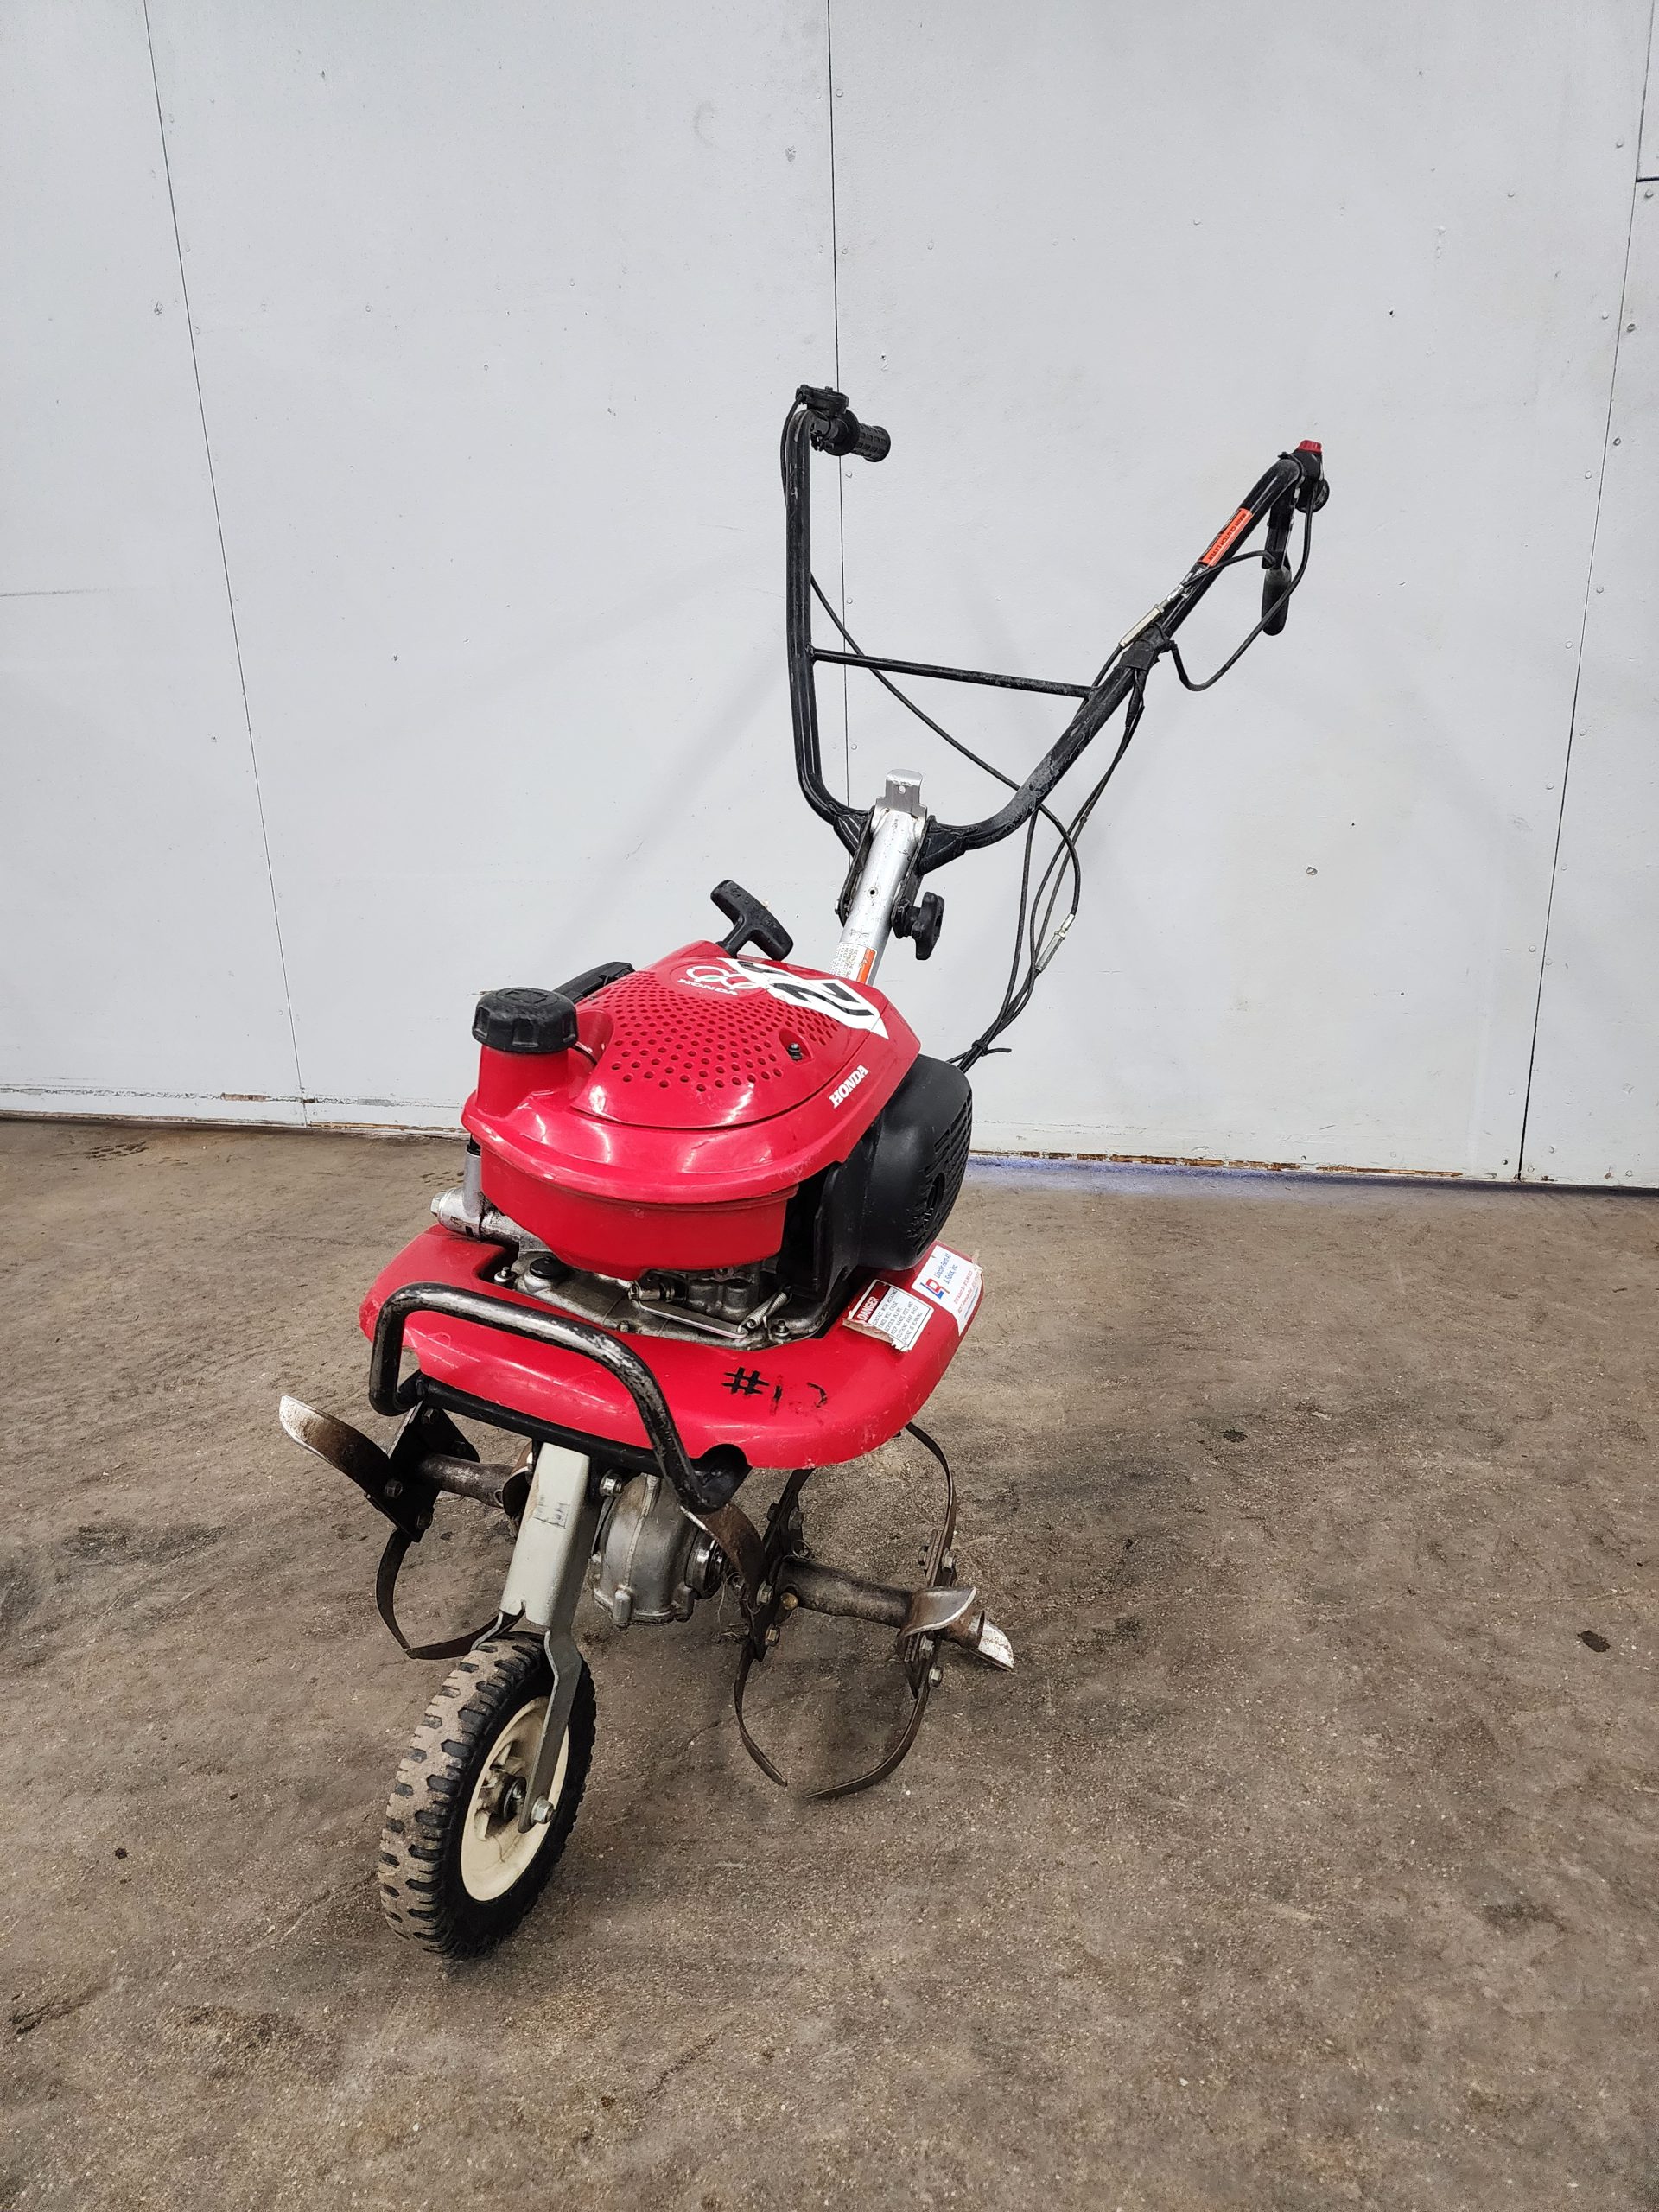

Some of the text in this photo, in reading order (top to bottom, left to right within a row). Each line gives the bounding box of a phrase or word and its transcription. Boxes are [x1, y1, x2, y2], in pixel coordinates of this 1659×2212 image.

[677, 978, 739, 996] HONDA
[829, 1065, 869, 1109] HONDA
[857, 1296, 880, 1321] DANGER
